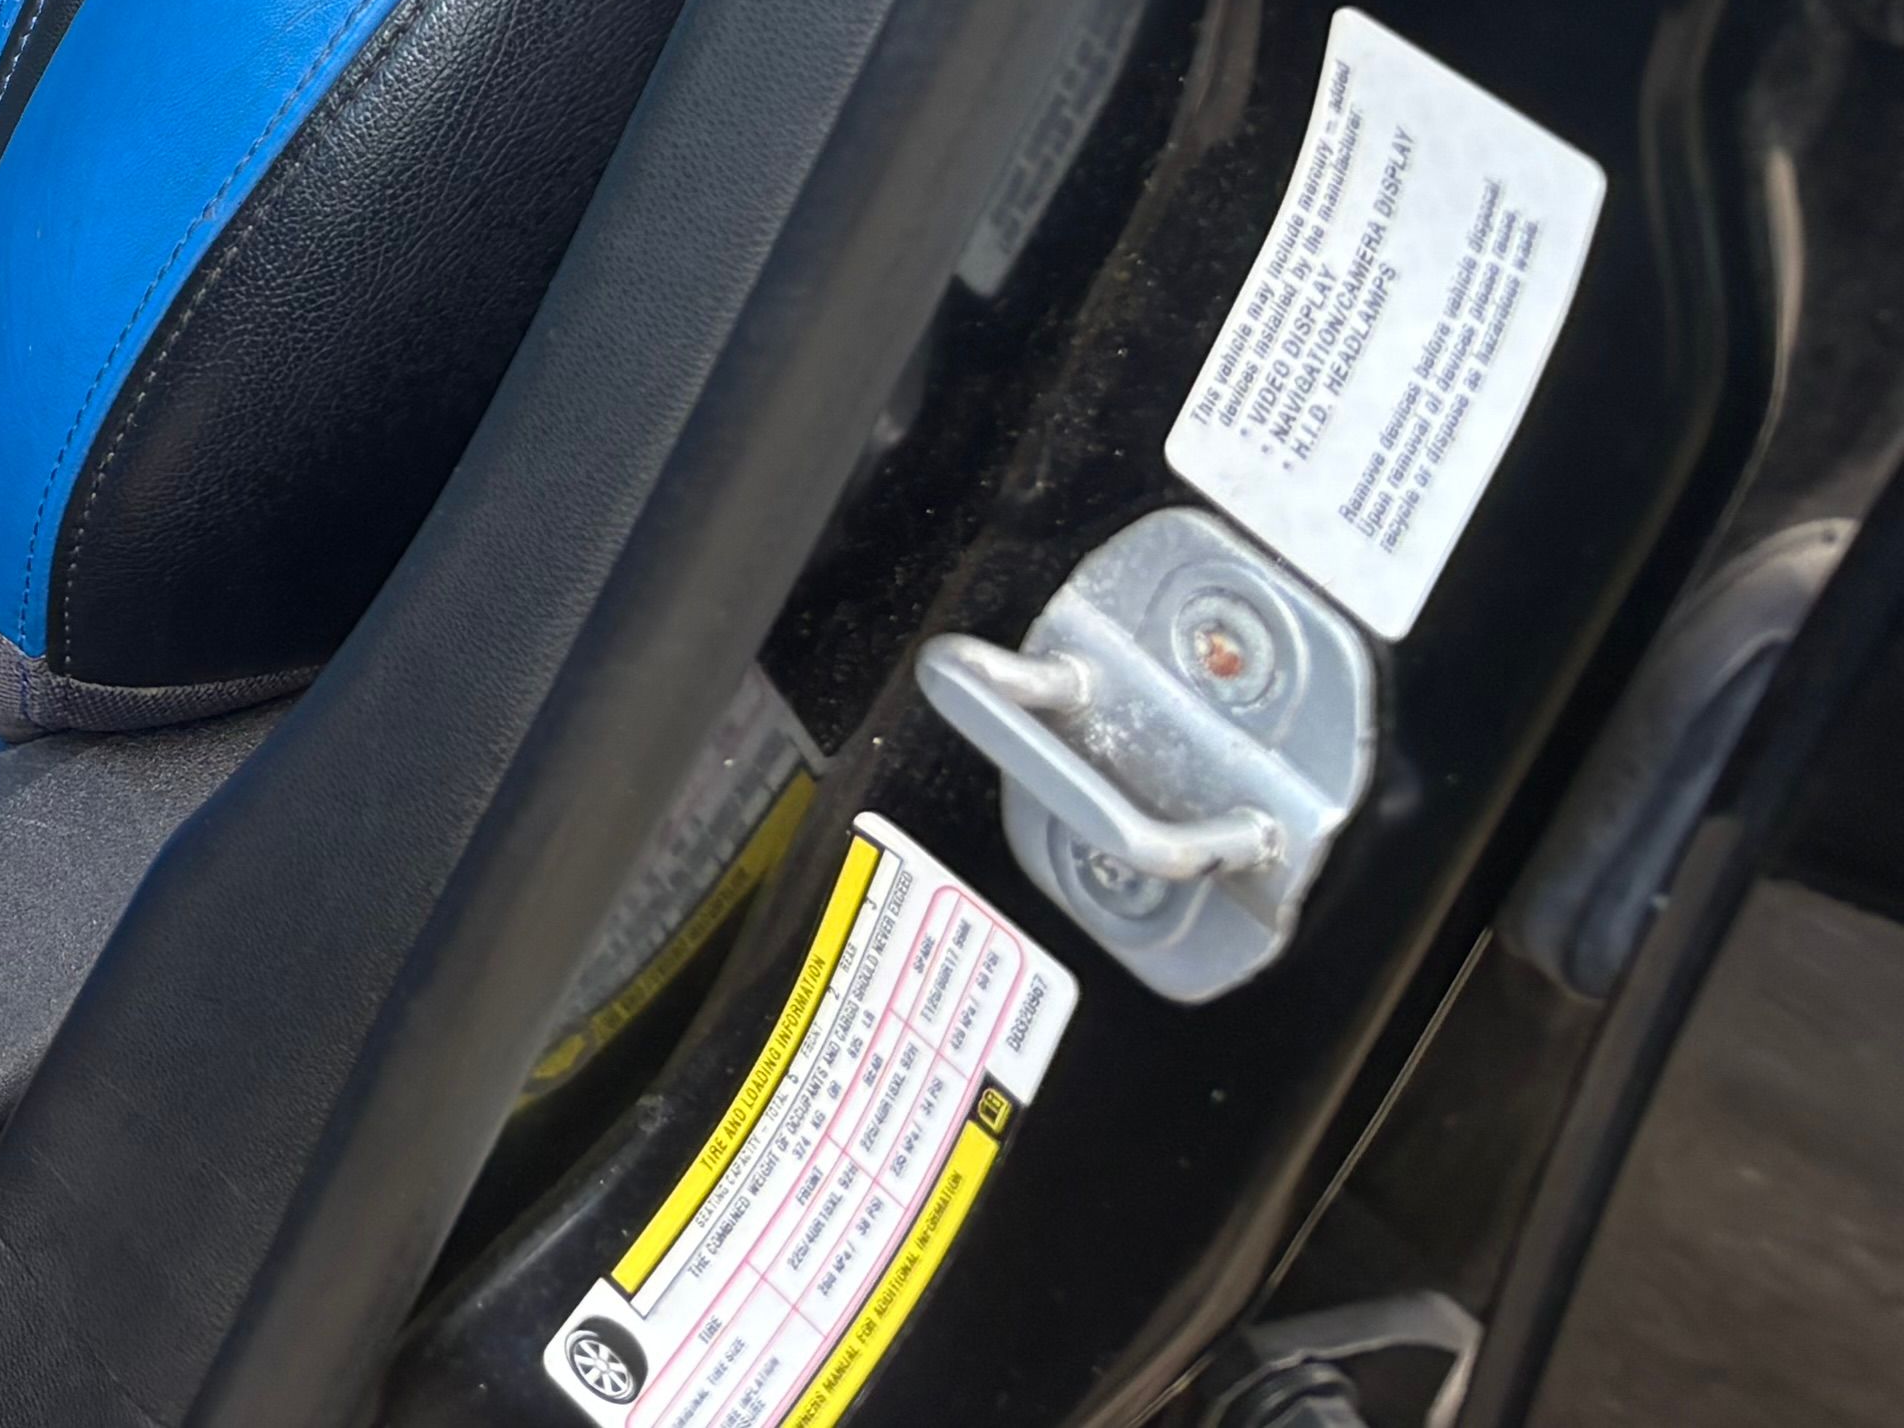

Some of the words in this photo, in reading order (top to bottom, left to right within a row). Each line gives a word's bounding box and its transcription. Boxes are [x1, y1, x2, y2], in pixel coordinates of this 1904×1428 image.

[1189, 384, 1219, 426] This
[1209, 319, 1252, 386] vehicle
[1245, 278, 1276, 322] may
[1263, 210, 1305, 279] include
[1249, 280, 1297, 360] installed
[1268, 216, 1386, 444] NAVIGATION/CAMERA
[1373, 124, 1416, 219] DISPLAY
[1288, 254, 1314, 283] by
[1300, 221, 1324, 255] the
[1215, 357, 1257, 427] devices
[1246, 355, 1290, 427] VIDEO
[1281, 262, 1338, 358] DISPLAY
[1289, 394, 1330, 461] H.I.D.
[1322, 260, 1396, 397] HEADLAMPS
[1337, 447, 1385, 524] Remove
[1376, 378, 1421, 450] devices
[1412, 318, 1450, 380] before
[1441, 253, 1477, 321] vehicle
[1357, 487, 1395, 541] Upon
[1384, 413, 1430, 489] removal
[1421, 389, 1442, 415] of
[1433, 321, 1476, 393] devices
[1377, 485, 1421, 554] recycle
[1414, 465, 1432, 489] or
[1423, 390, 1471, 466] dispose
[1464, 366, 1482, 392] as
[687, 1251, 711, 1280] THE
[703, 1193, 751, 1257] COMBINED
[745, 1149, 779, 1197] WEIGHT
[774, 1129, 792, 1152] OF
[784, 1064, 828, 1136] OCCUPANTS
[821, 1039, 841, 1067] AND
[833, 998, 861, 1043] CARGO
[851, 952, 879, 1002] SHOULD
[871, 914, 895, 955] NEVER
[887, 869, 914, 917] EXCEED
[693, 1182, 729, 1229] SEATING
[724, 1133, 761, 1186] CAPACITY
[765, 1087, 789, 1121] TOTAL
[798, 1019, 823, 1060] FRONT
[839, 940, 858, 973] REAR
[700, 1135, 727, 1172] TIRE
[721, 1105, 746, 1140] AND
[739, 1045, 782, 1109] LOADING
[773, 953, 826, 1049] INFORMATION
[794, 1164, 824, 1206] FRONT
